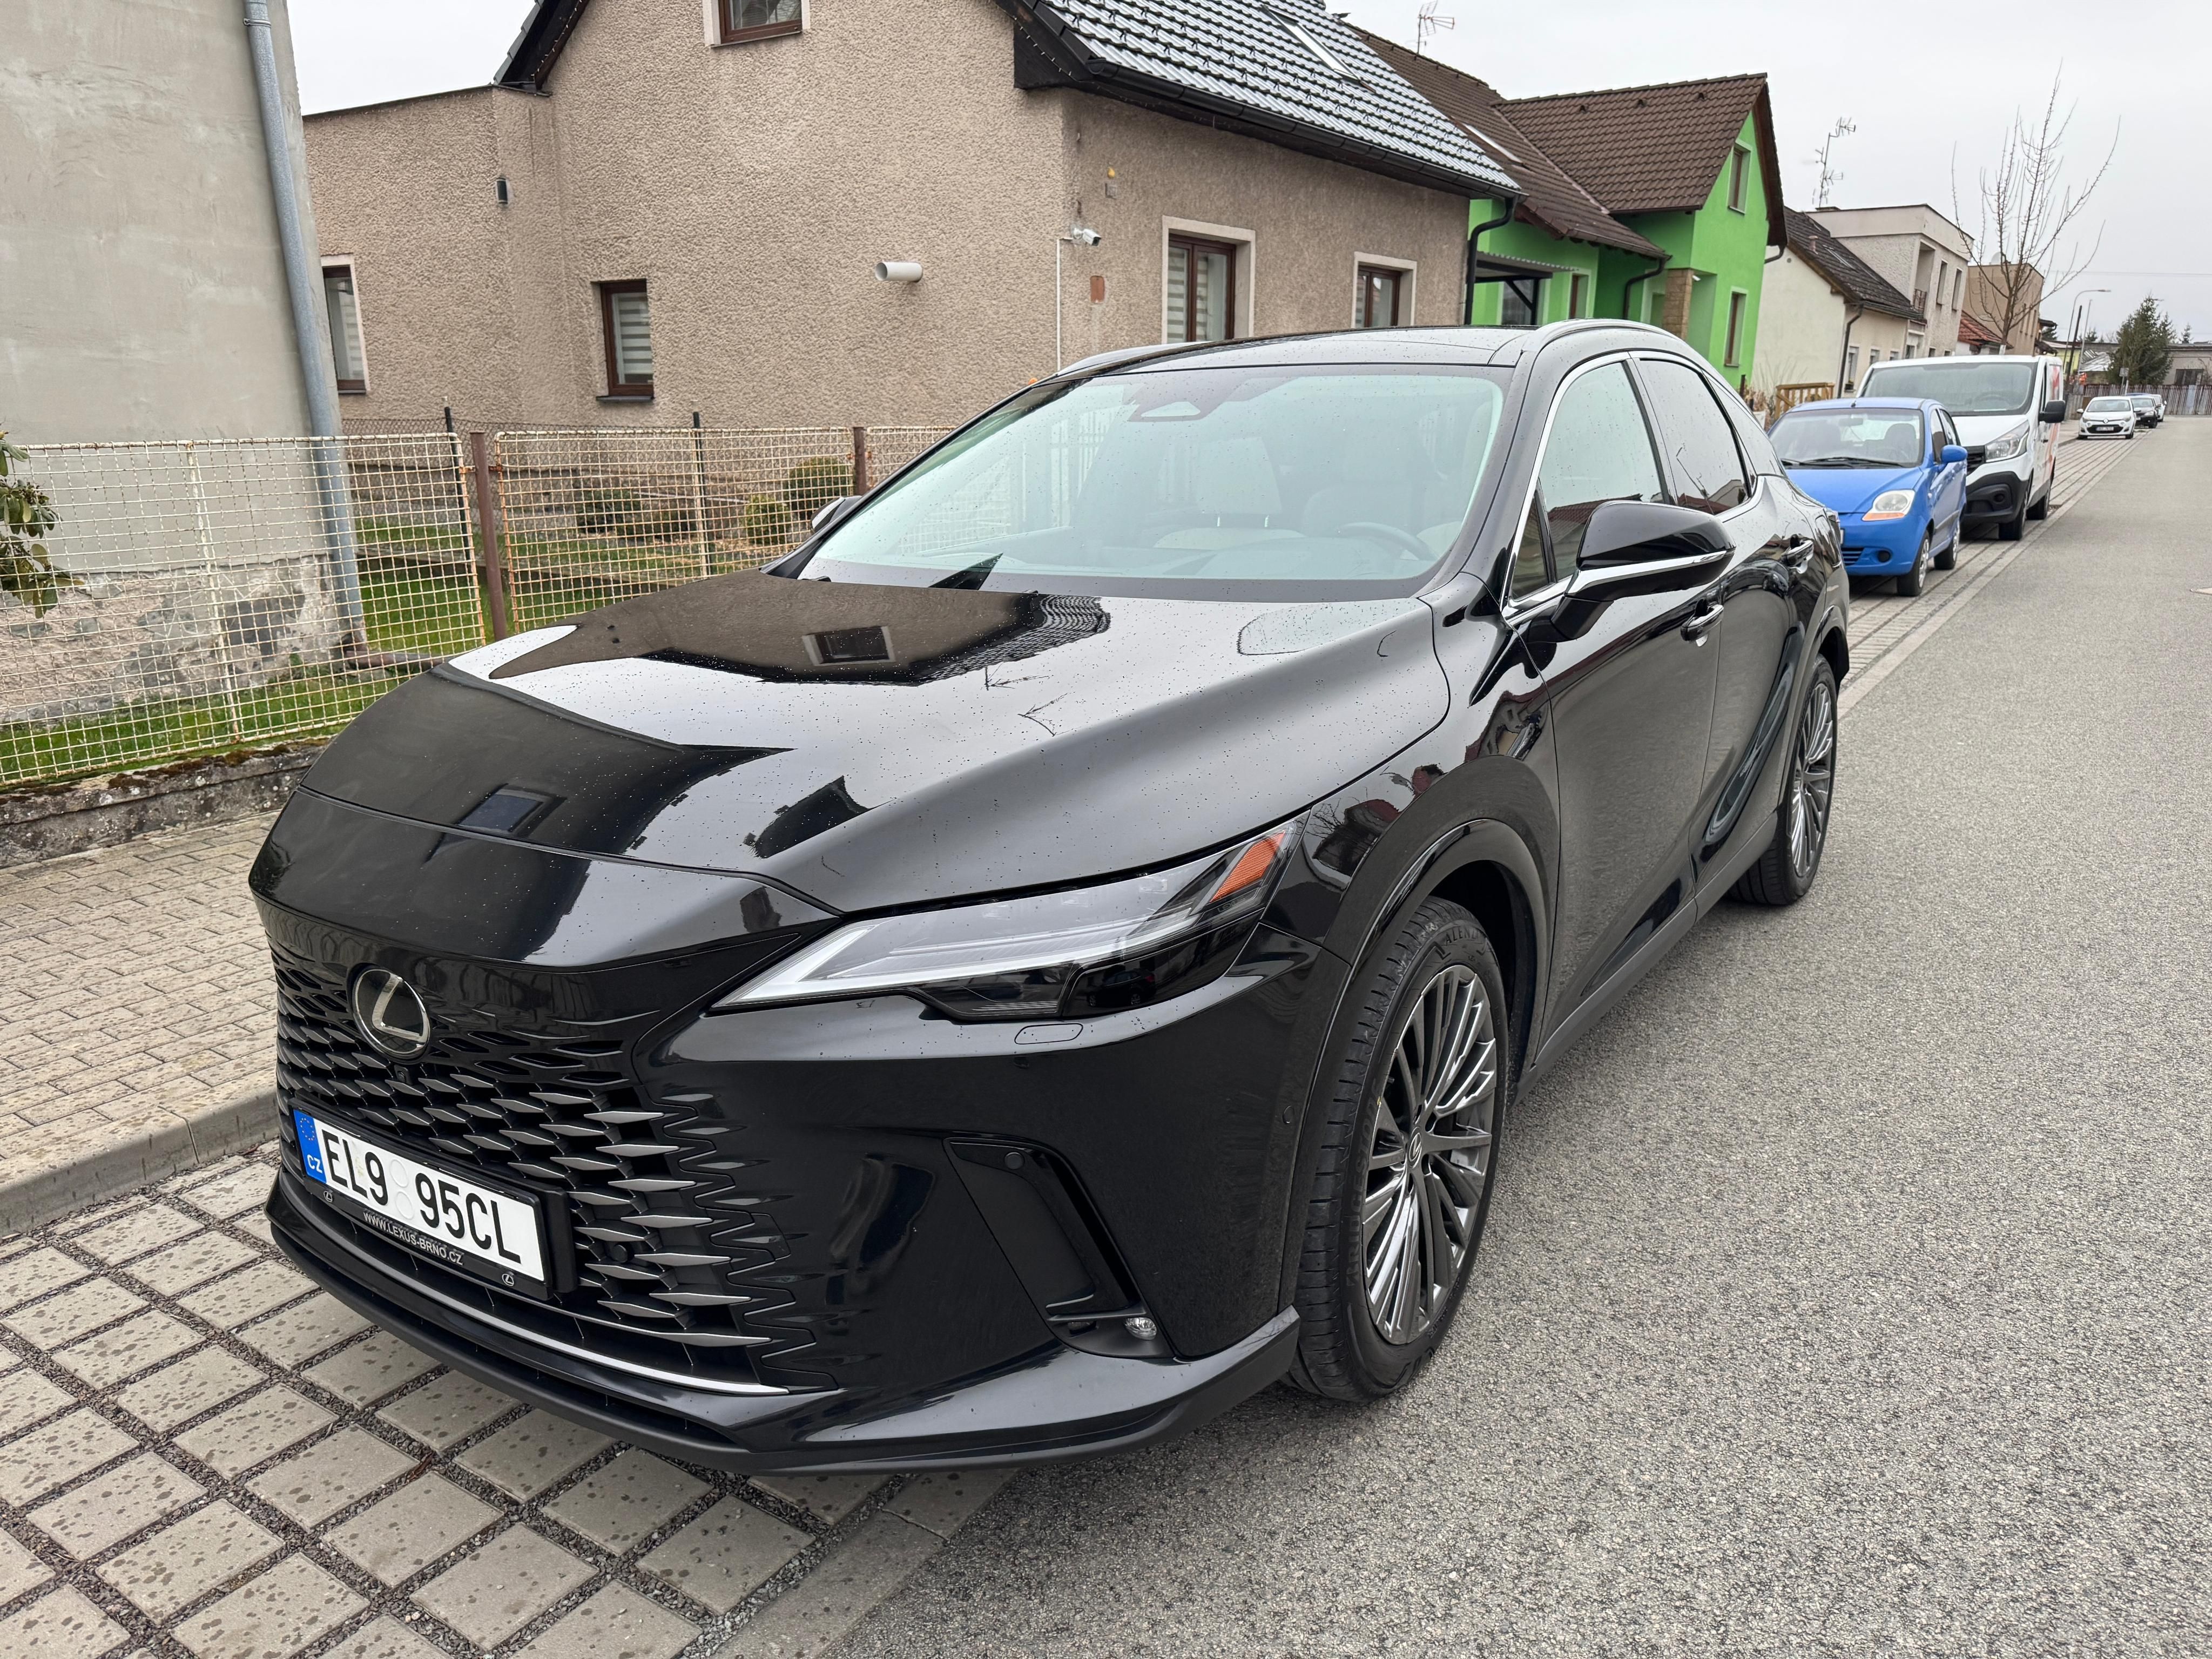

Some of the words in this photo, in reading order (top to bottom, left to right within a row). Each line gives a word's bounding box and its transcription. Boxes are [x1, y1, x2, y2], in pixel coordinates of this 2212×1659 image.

[307, 1154, 323, 1174] CZ
[321, 1129, 388, 1206] EL9
[414, 1172, 521, 1264] 95CL
[363, 1212, 464, 1266] WWW.LEXUS-BRNO.CZ
